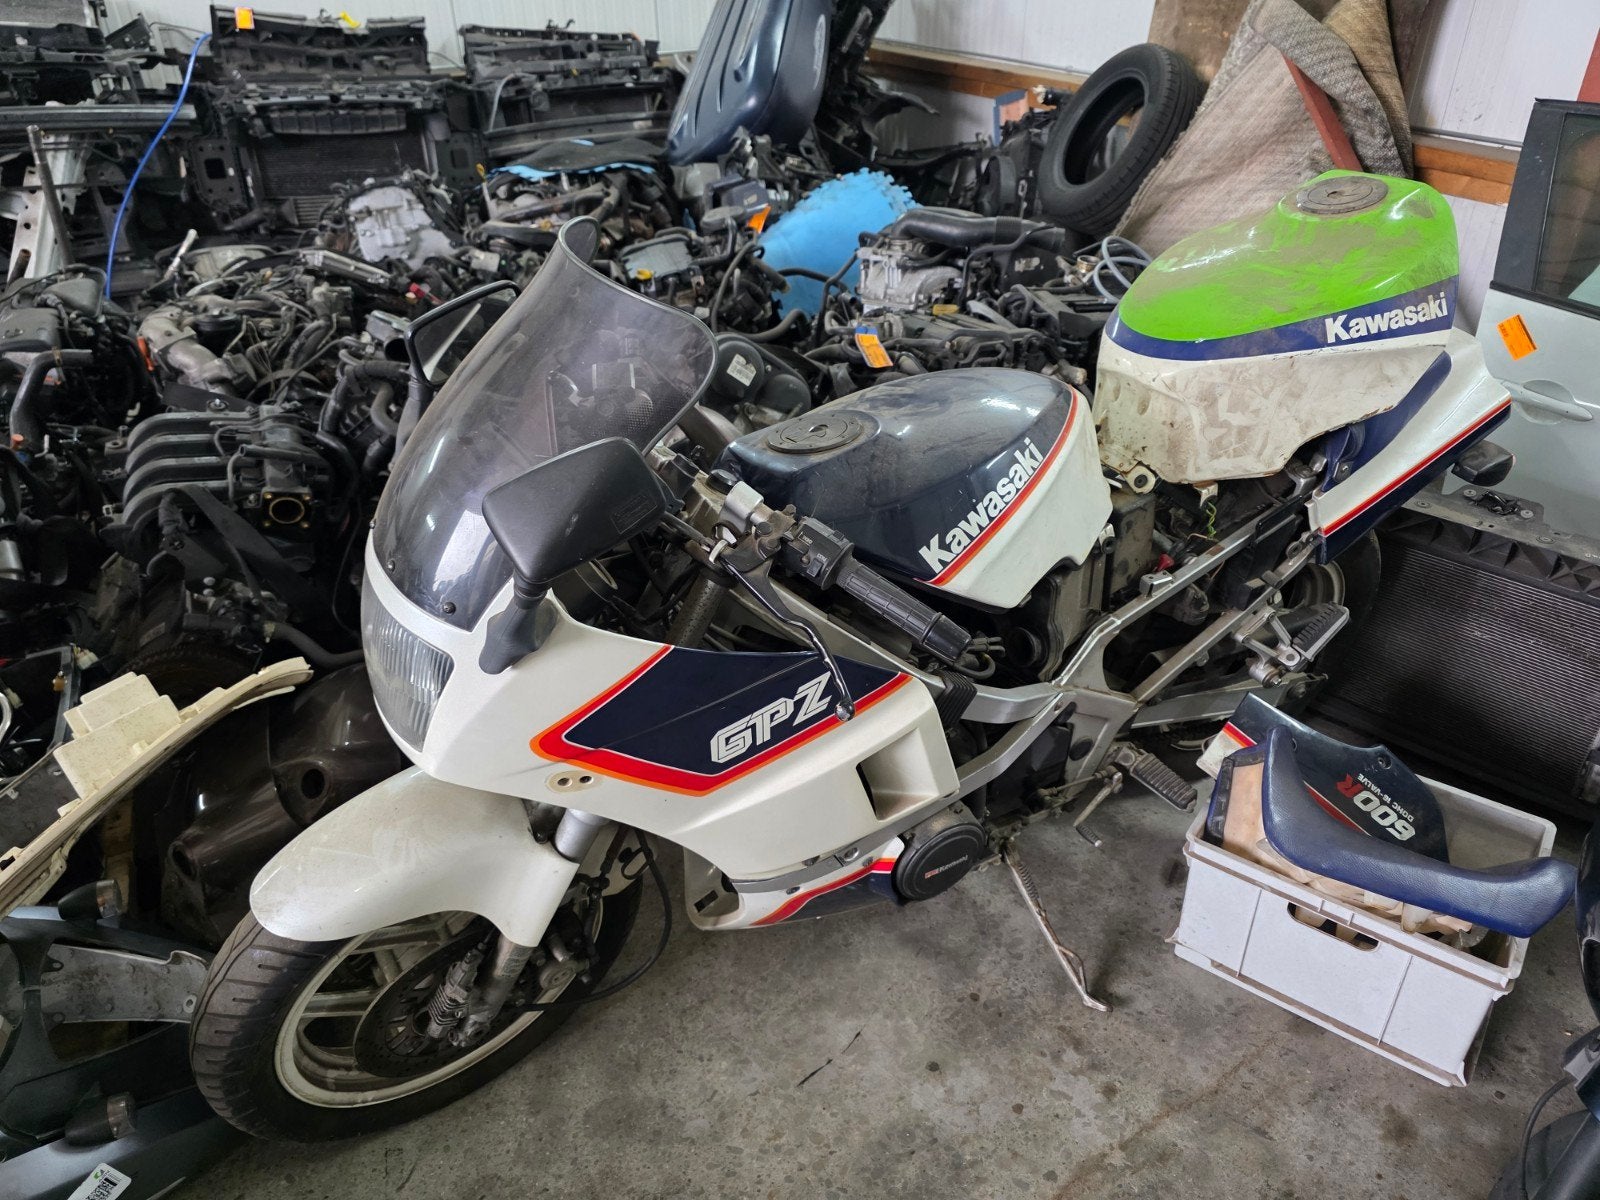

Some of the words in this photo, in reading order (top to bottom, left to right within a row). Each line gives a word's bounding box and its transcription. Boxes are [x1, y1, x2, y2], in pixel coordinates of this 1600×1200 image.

[1325, 292, 1448, 343] Kawasaki
[918, 437, 1044, 574] Kawasaki
[710, 671, 832, 763] GPZ
[1336, 773, 1416, 841] 600R
[1357, 773, 1391, 803] 16-VALVE
[1391, 802, 1414, 822] DOHC
